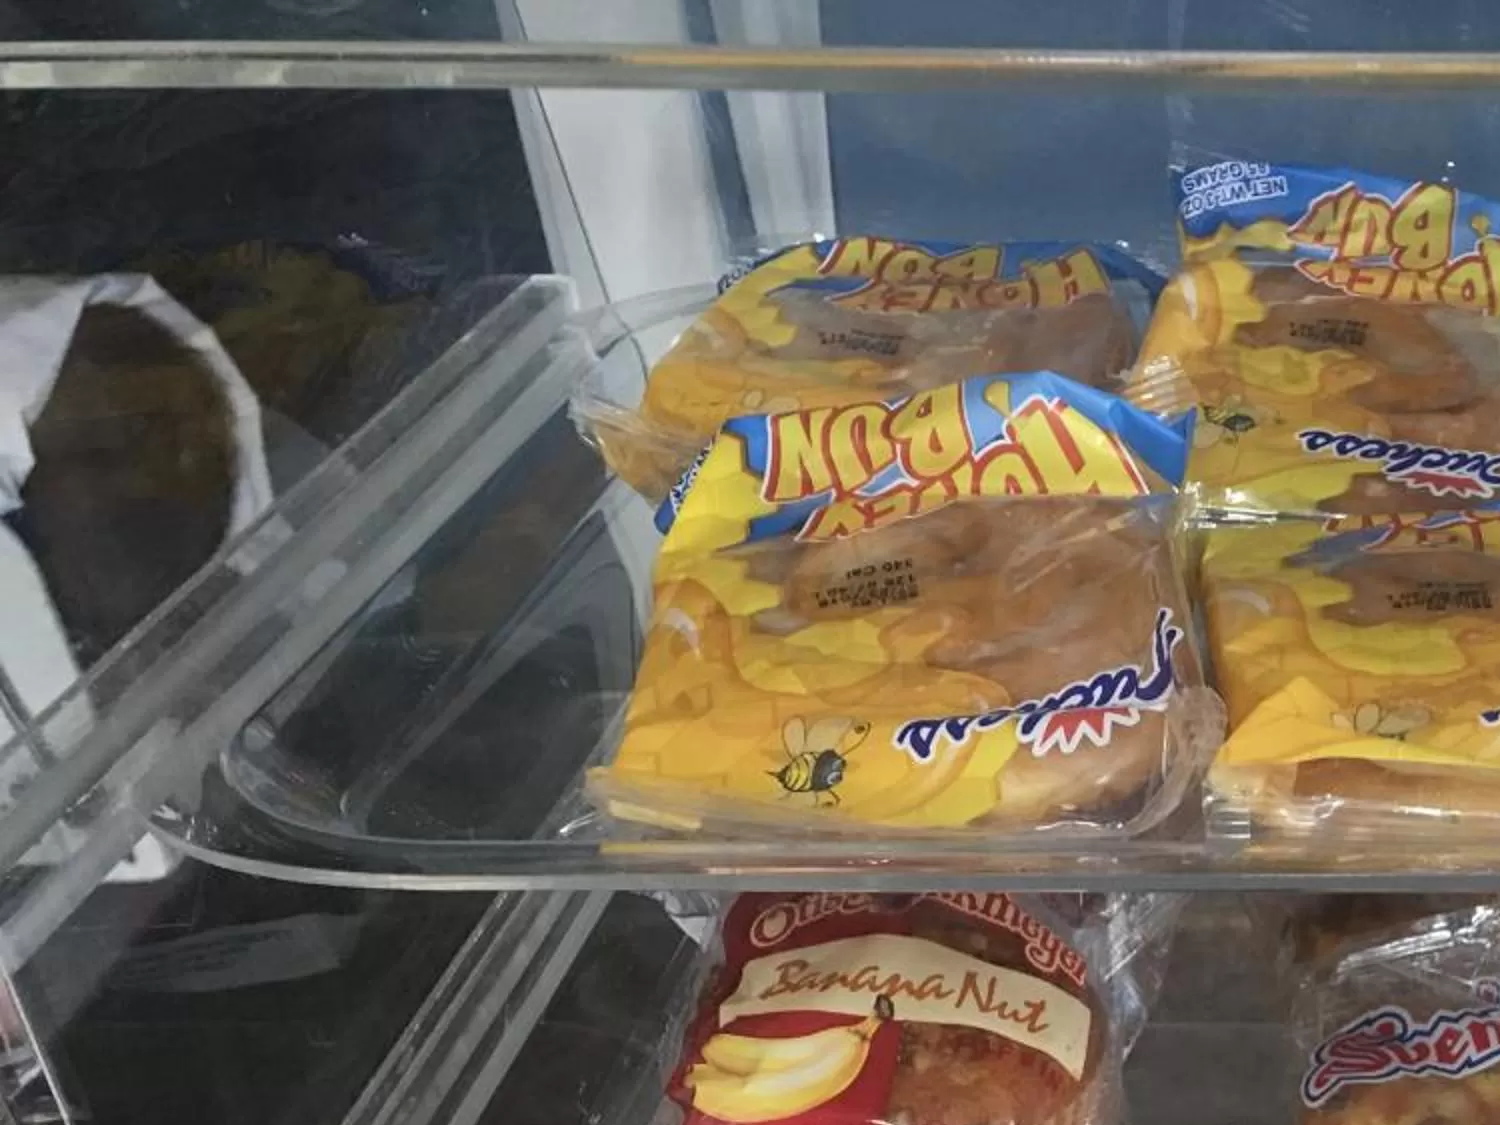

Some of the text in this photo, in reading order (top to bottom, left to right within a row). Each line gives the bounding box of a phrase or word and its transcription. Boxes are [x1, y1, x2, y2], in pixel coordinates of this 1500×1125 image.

[1182, 162, 1246, 194] GRAMS
[1286, 182, 1458, 272] BUN
[762, 383, 967, 502] BUN
[758, 958, 1050, 1033] Banana Nut
